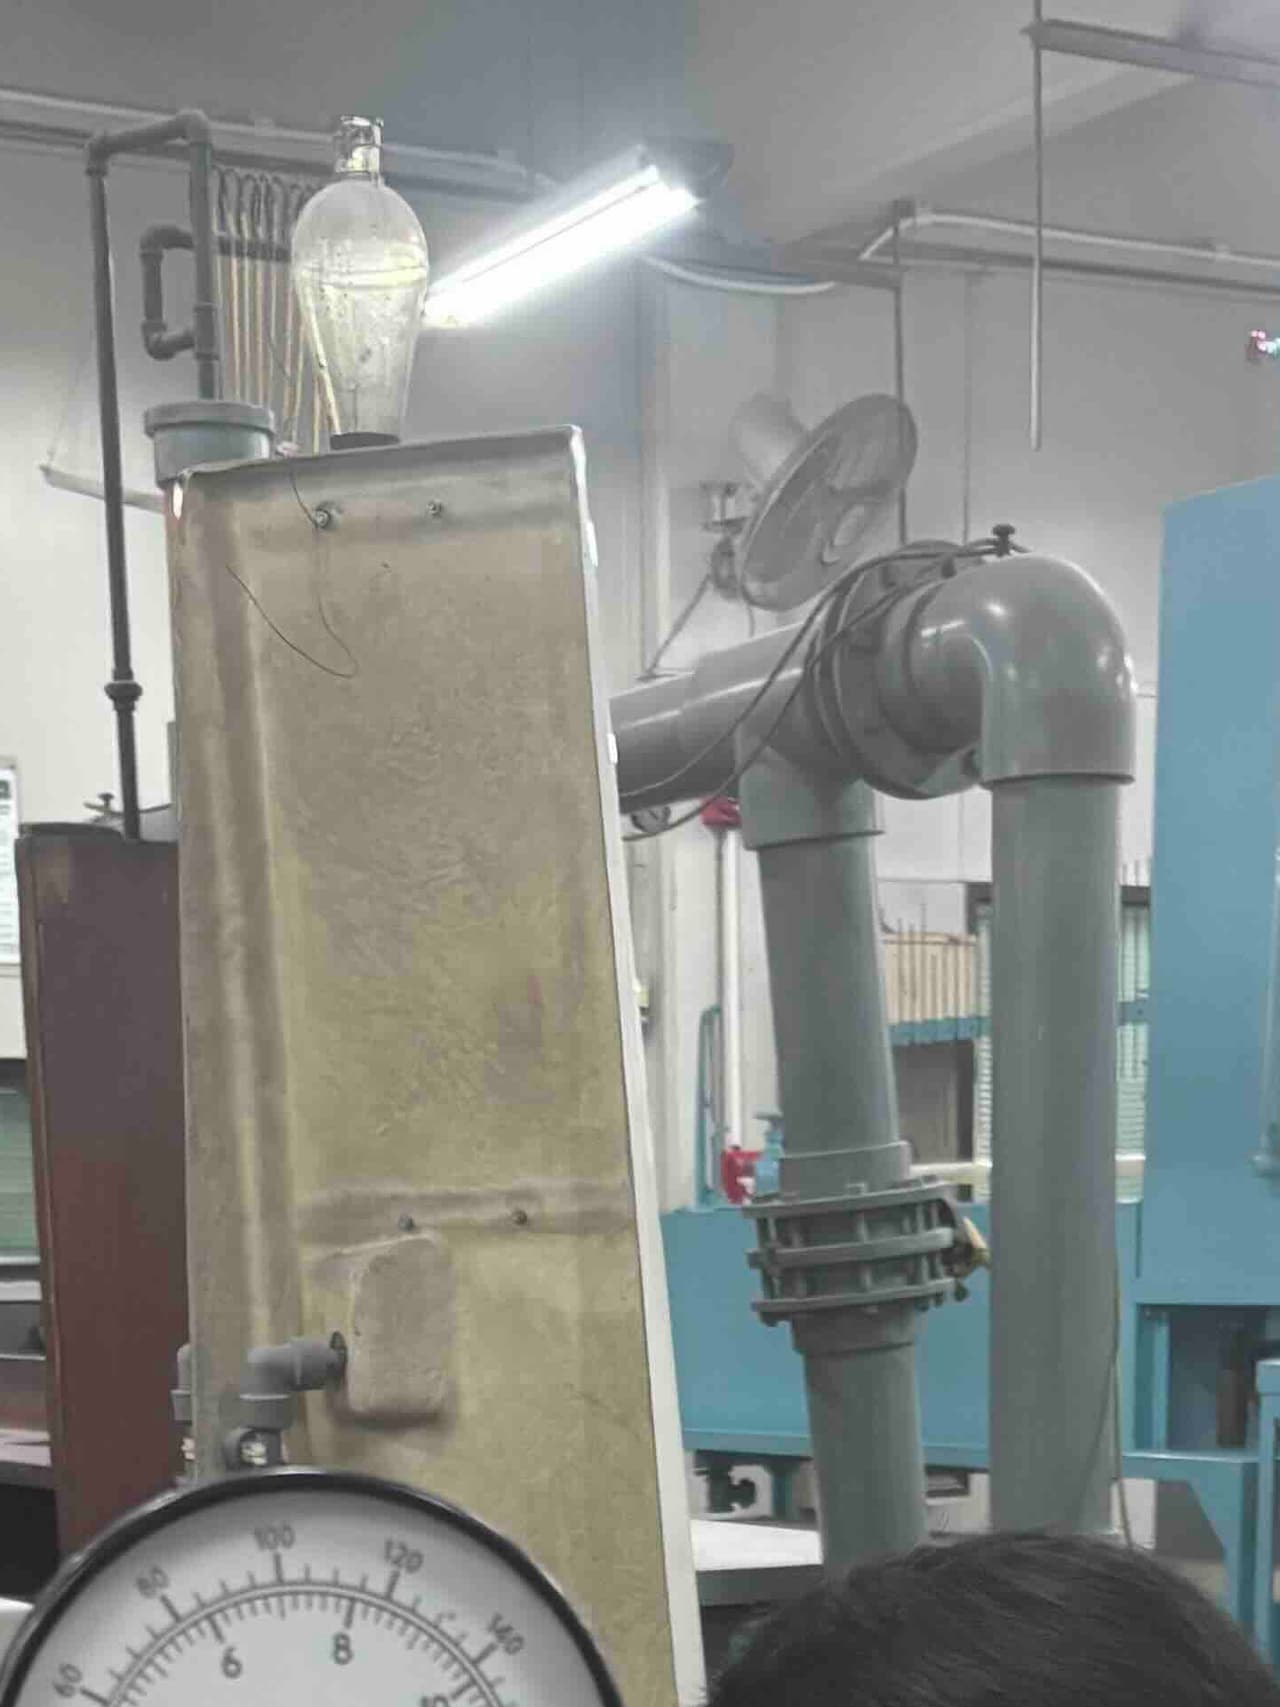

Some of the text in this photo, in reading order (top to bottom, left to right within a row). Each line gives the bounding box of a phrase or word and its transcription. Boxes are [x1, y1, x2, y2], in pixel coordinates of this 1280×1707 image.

[253, 1524, 296, 1551] 100
[382, 1538, 424, 1575] 120
[135, 1567, 170, 1597] 80
[485, 1611, 525, 1657] 140
[220, 1648, 243, 1679] 6
[331, 1637, 353, 1664] 8
[53, 1665, 83, 1700] 60
